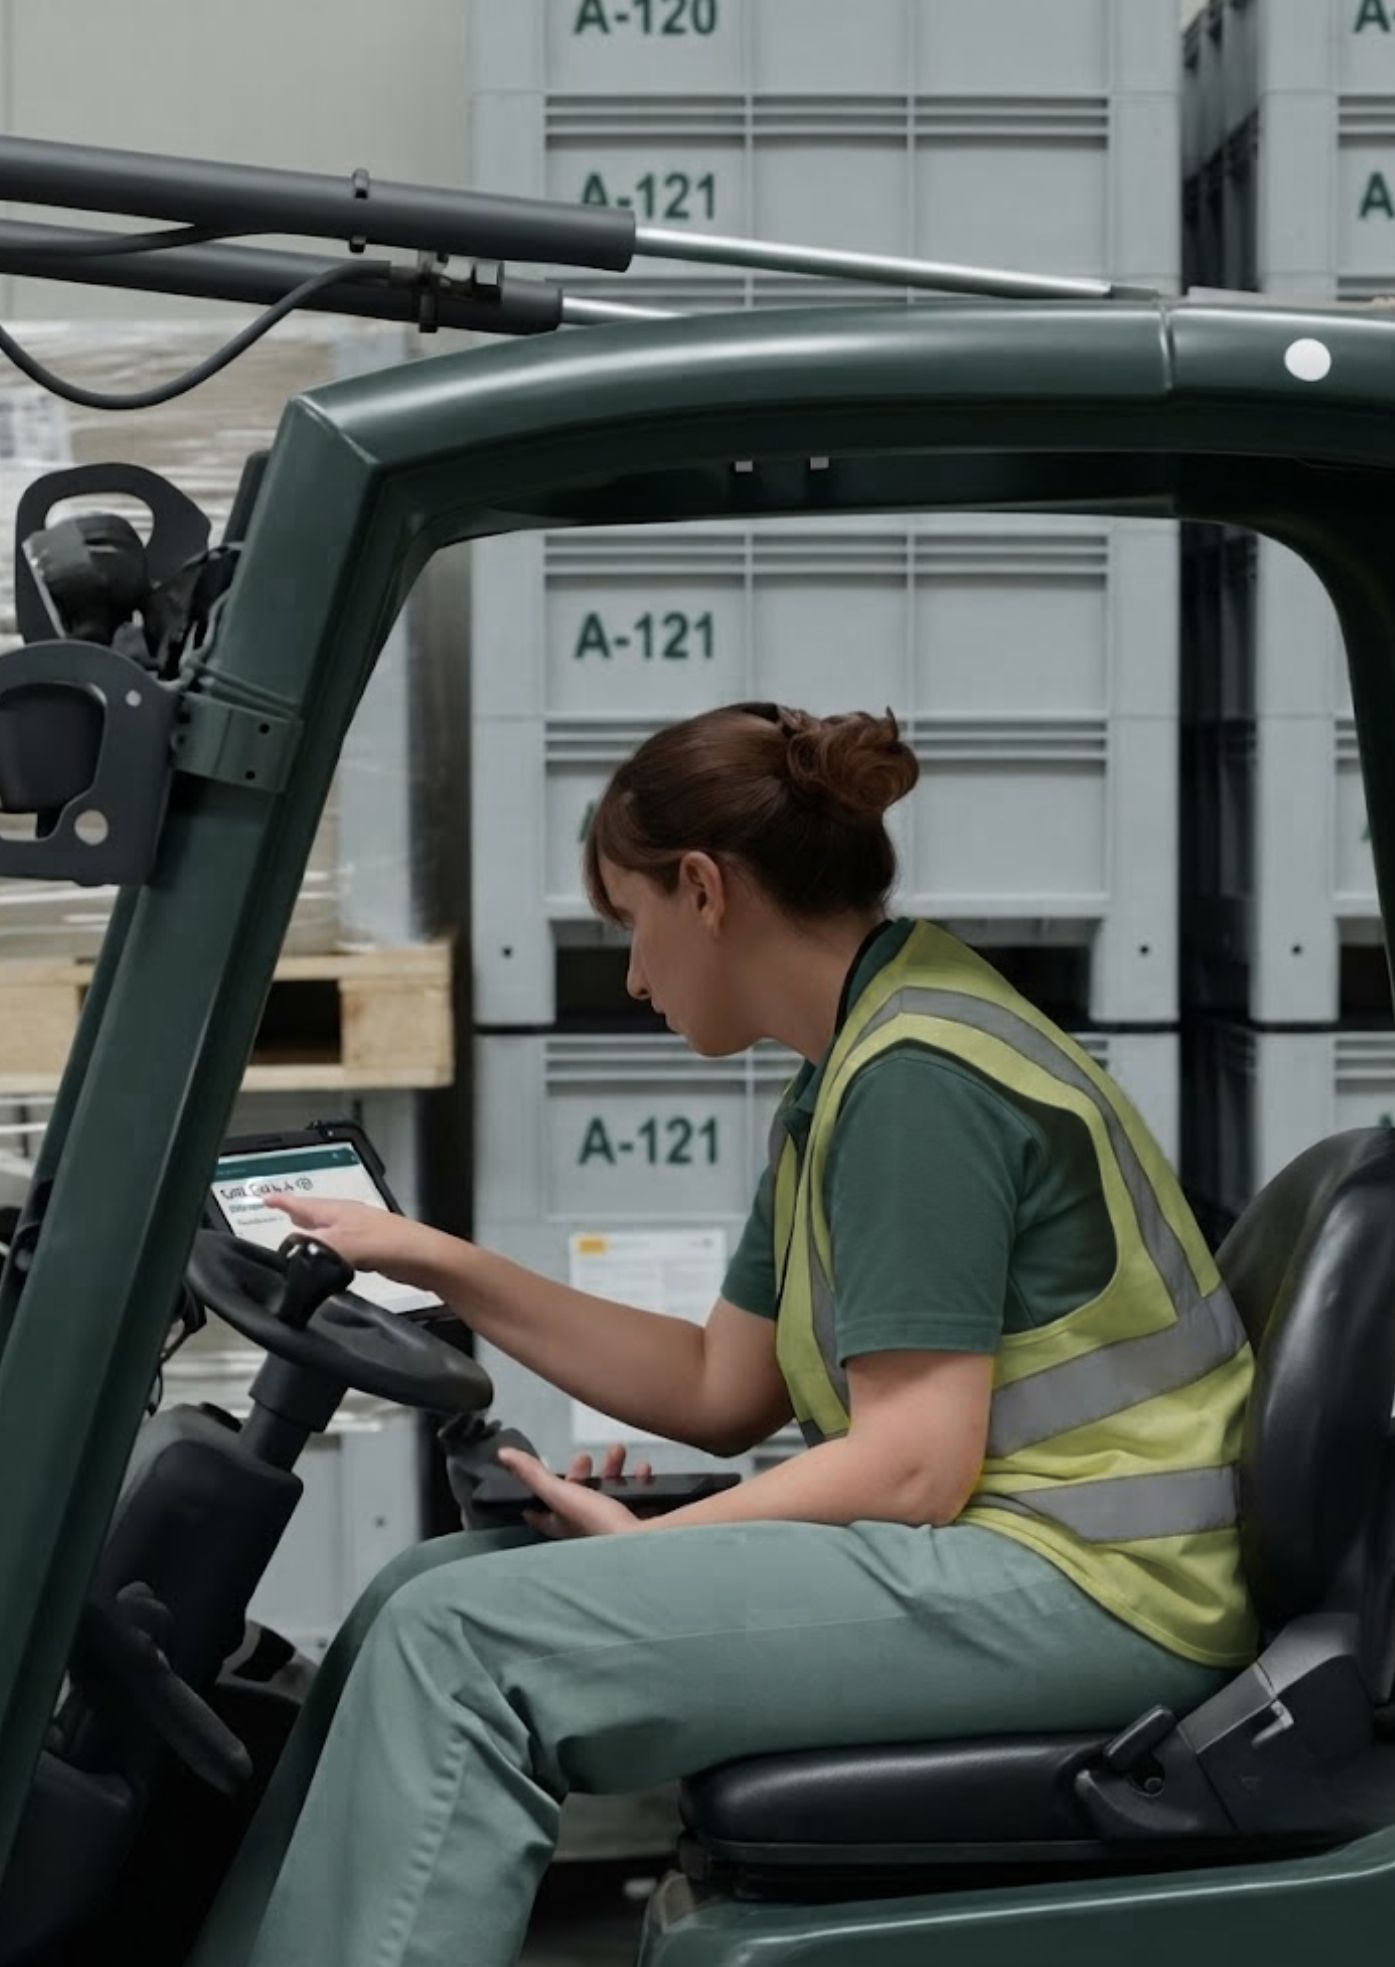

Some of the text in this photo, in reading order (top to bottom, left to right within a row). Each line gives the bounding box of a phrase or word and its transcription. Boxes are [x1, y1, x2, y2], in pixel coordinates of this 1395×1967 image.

[574, 0, 717, 36] A-120
[1353, 0, 1395, 34] A
[581, 171, 716, 220] A-121
[574, 611, 714, 660] A-121
[577, 1116, 717, 1166] A-121
